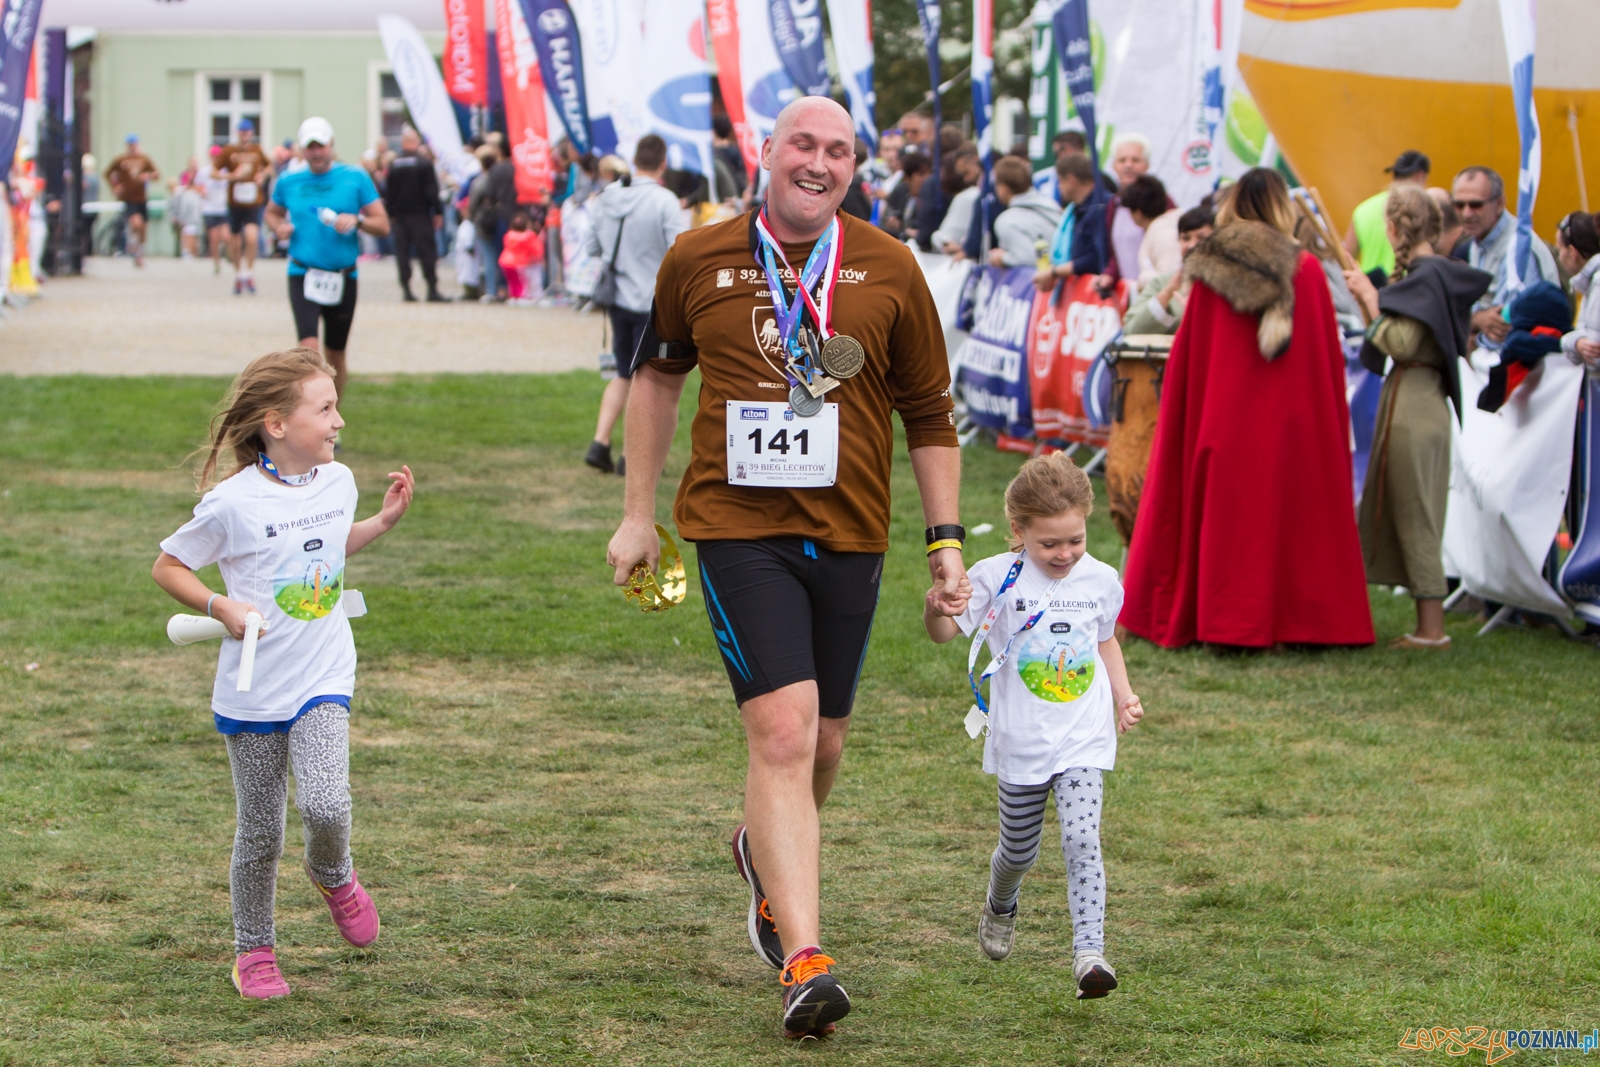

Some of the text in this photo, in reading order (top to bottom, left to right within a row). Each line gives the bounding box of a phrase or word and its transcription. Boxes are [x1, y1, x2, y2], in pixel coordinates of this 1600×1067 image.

[740, 269, 757, 279] 39
[827, 347, 840, 359] 26
[748, 428, 809, 455] 141
[749, 463, 826, 472] 39 BIEG LECHITÓW
[278, 523, 289, 531] 39
